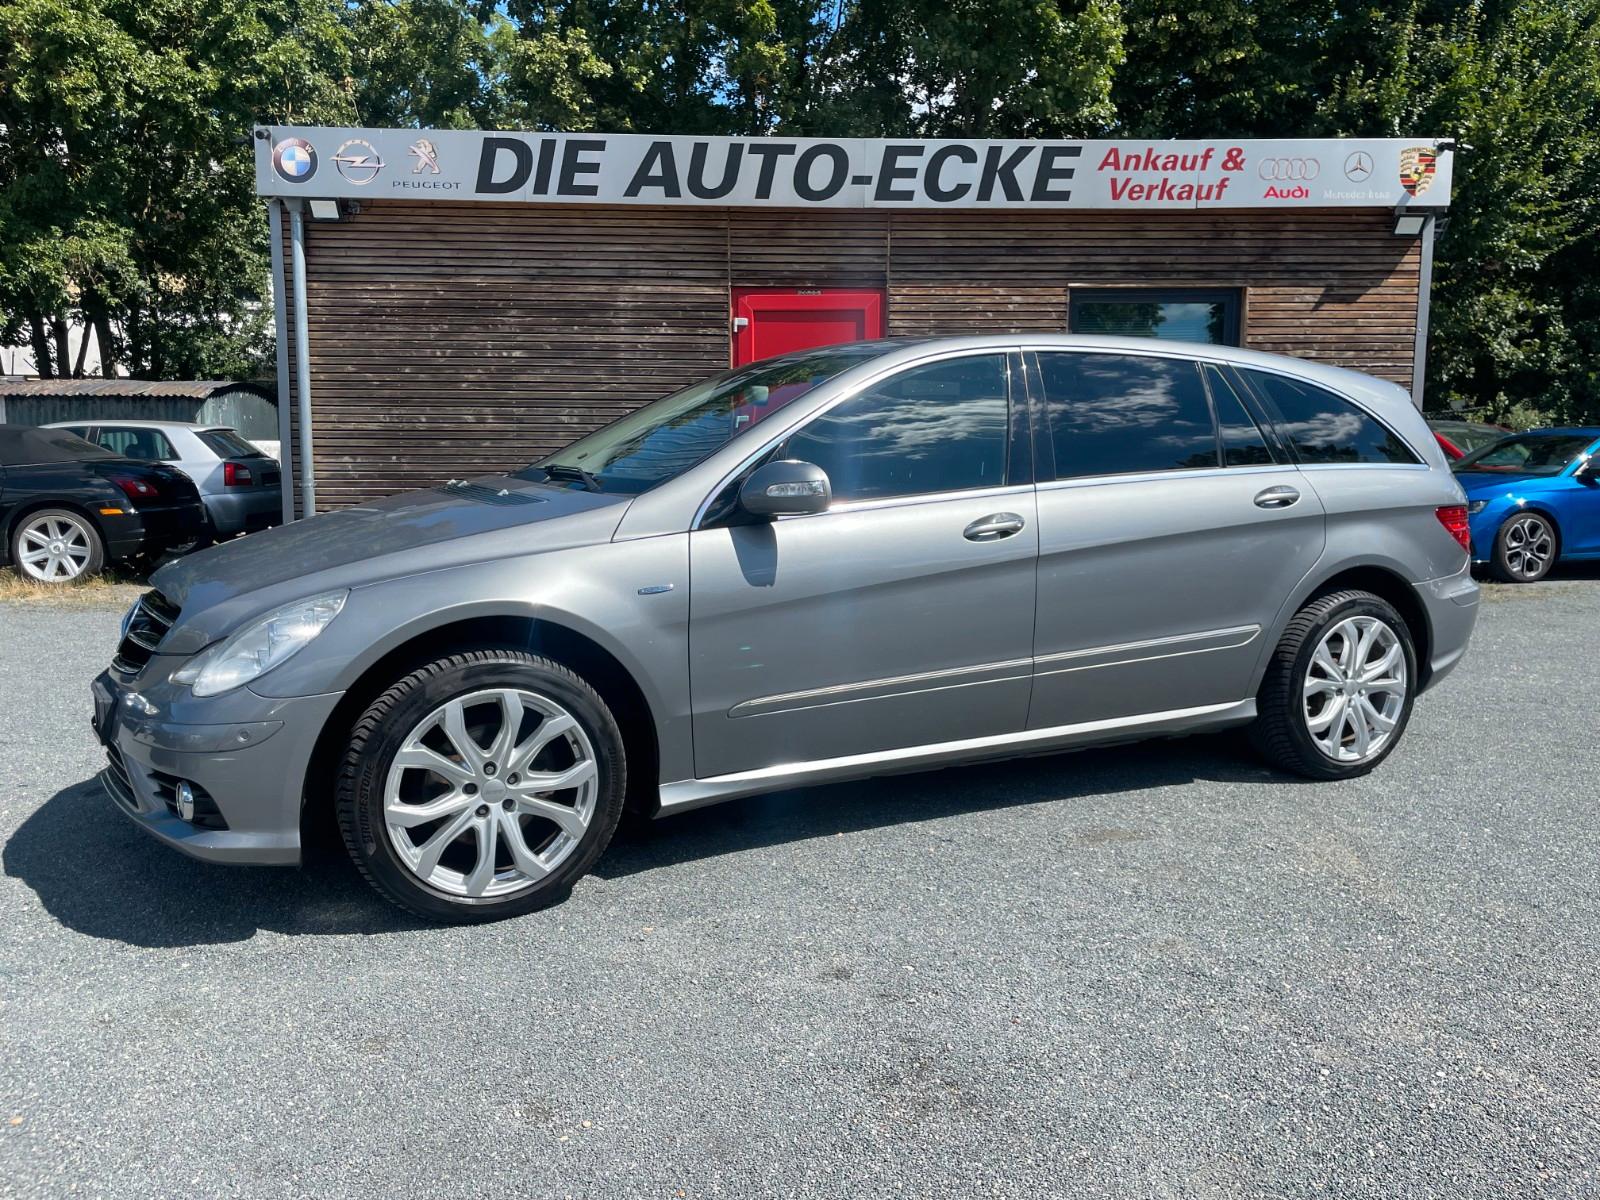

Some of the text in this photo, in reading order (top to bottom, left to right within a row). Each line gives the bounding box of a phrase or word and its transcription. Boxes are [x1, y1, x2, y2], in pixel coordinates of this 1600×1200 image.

[475, 137, 1083, 202] DIE AUTO-ECKE
[1098, 147, 1246, 171] Ankauf &
[392, 180, 461, 190] PEUGEOT
[1109, 177, 1231, 201] Verkauf
[1263, 185, 1309, 199] Audi
[358, 760, 375, 845] BRIDGESTONE
